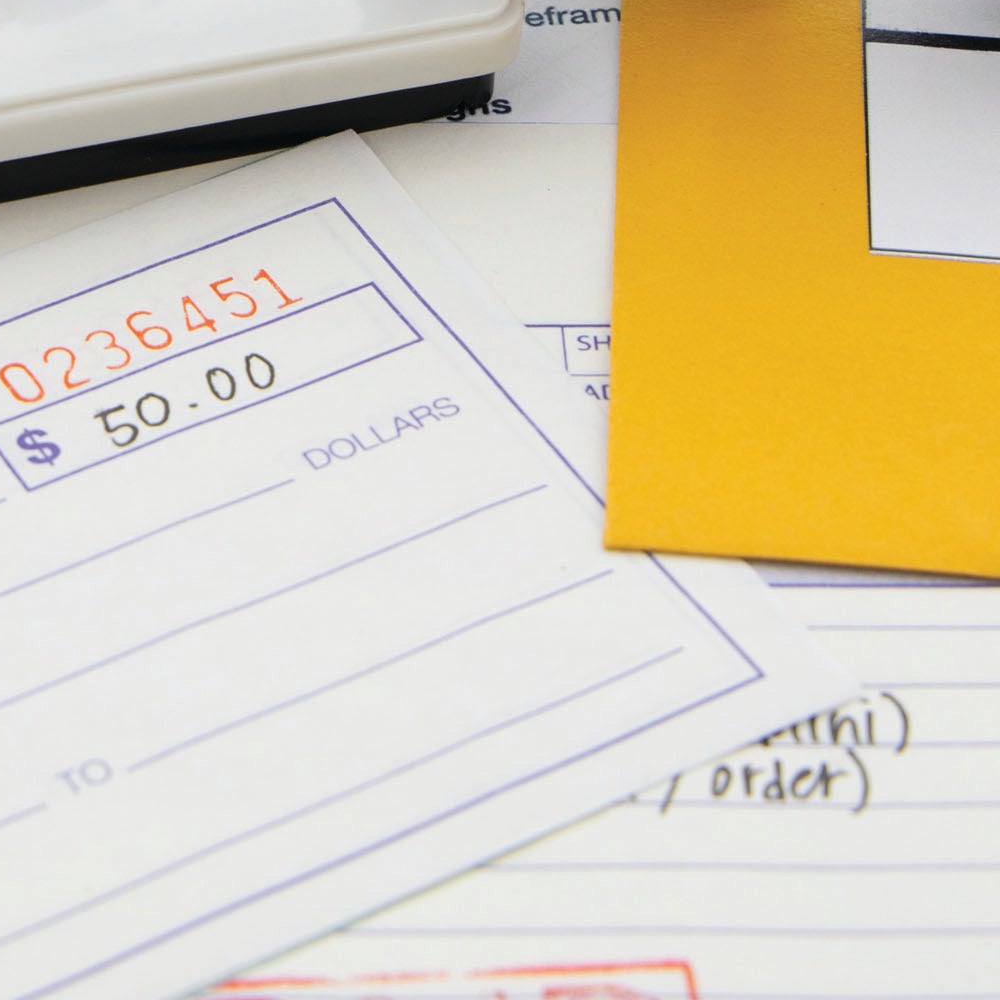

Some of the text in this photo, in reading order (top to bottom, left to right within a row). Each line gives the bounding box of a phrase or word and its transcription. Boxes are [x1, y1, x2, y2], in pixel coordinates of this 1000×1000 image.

[93, 351, 278, 450] 50.00
[16, 427, 63, 467] $
[301, 396, 462, 473] DOLLARS
[53, 757, 115, 796] TO
